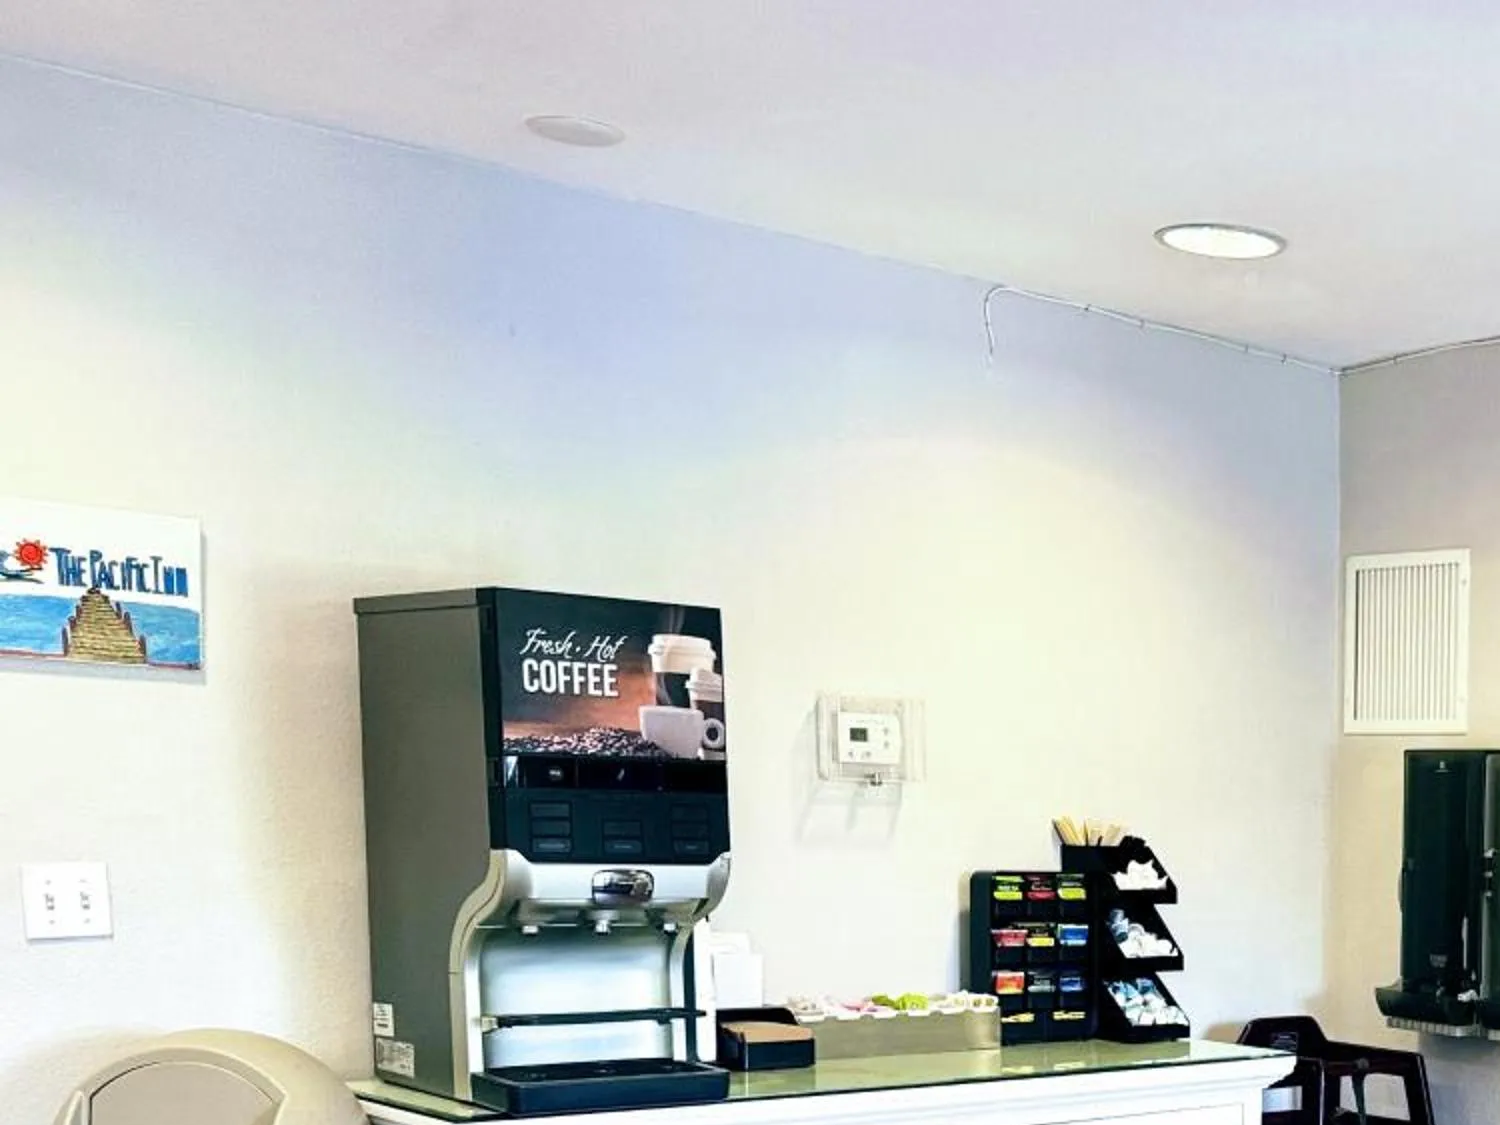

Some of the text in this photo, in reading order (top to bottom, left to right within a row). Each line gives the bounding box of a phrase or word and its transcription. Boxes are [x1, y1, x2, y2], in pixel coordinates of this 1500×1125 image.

[519, 627, 627, 663] Fresh Hot
[521, 657, 619, 697] COFFEE
